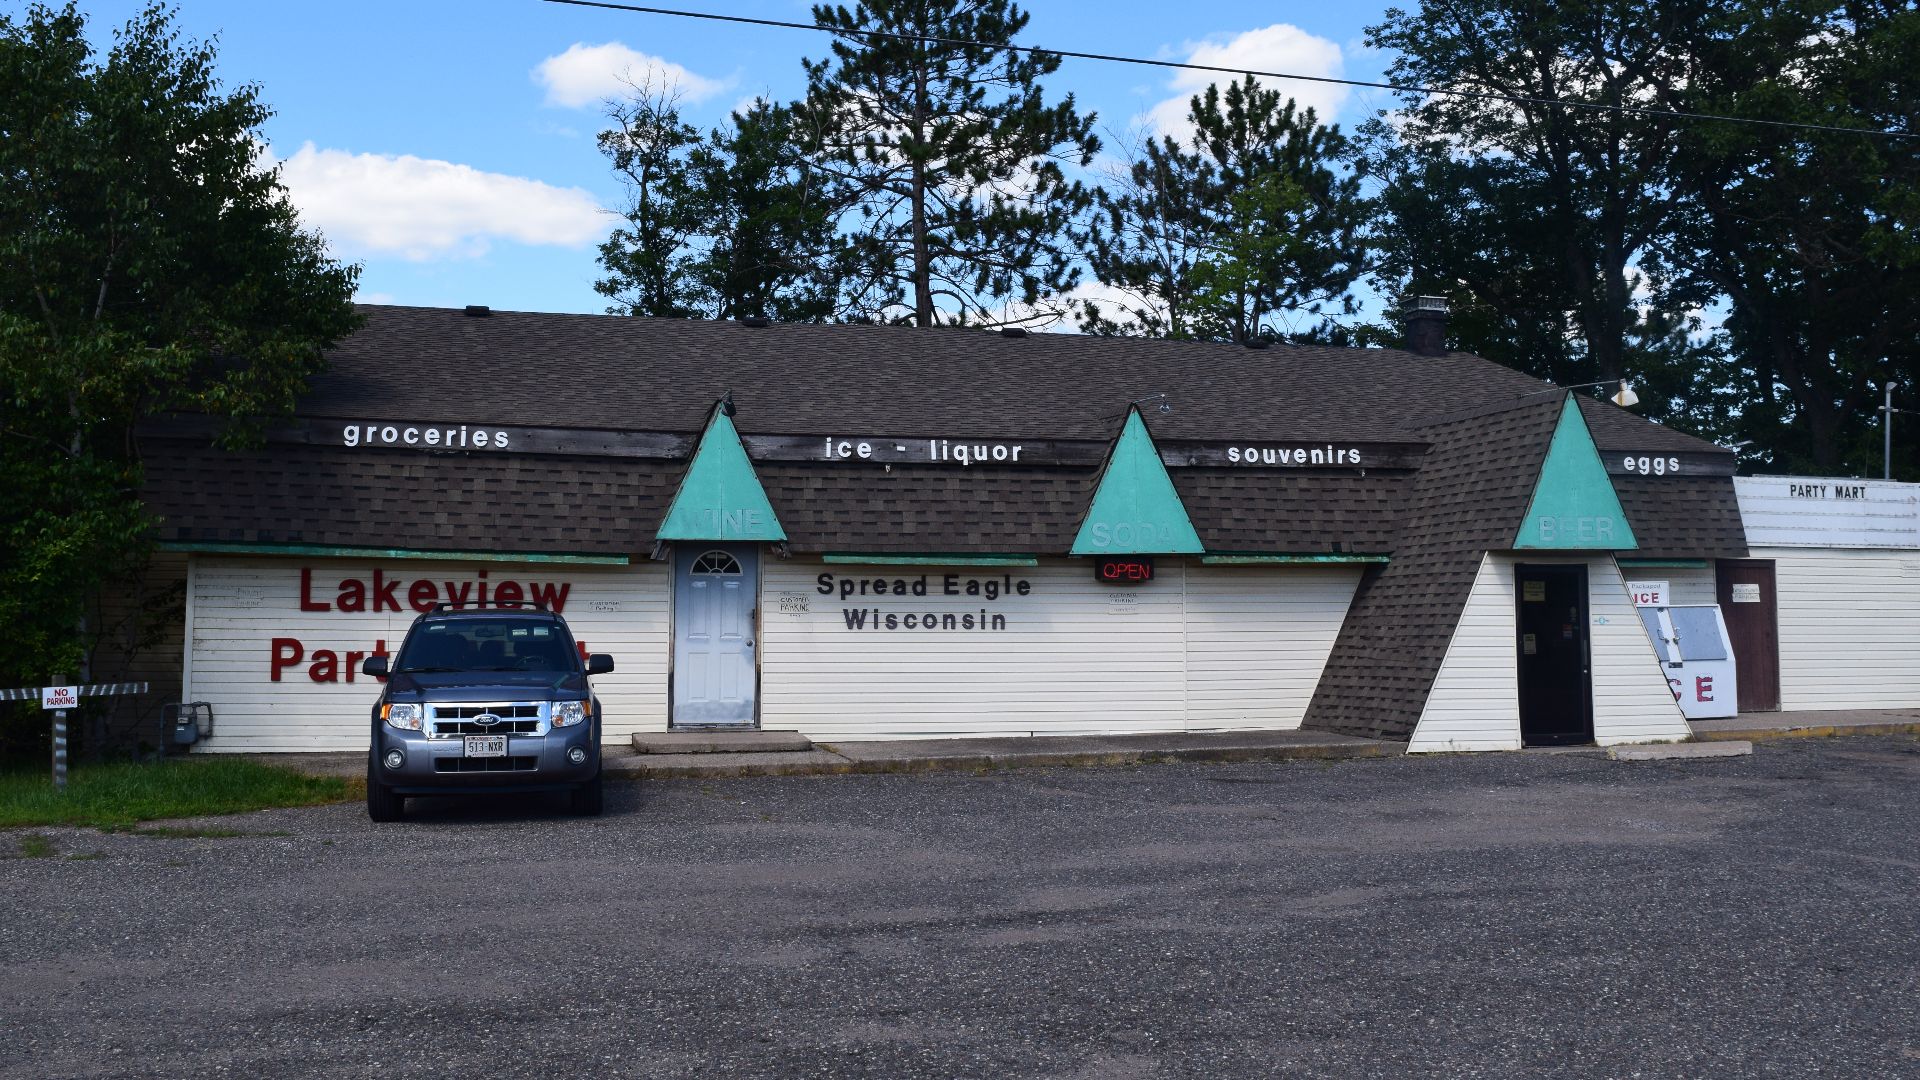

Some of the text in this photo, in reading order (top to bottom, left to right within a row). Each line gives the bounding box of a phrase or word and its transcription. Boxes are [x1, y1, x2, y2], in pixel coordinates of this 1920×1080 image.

[343, 425, 509, 448] groceries
[825, 437, 872, 459] ice
[930, 440, 1022, 465] liquor
[1228, 444, 1361, 464] souvenirs
[1623, 456, 1680, 476] eggs
[1790, 484, 1866, 499] PARTY MART
[1091, 522, 1177, 547] SODA
[1538, 516, 1615, 542] BEER
[1103, 563, 1150, 579] OPEN
[300, 568, 571, 614] Lakeview
[816, 573, 1031, 600] Spread Eagle
[1633, 592, 1660, 604] ICE
[843, 608, 1006, 630] Wisconsin
[46, 696, 76, 706] PARKING
[54, 688, 69, 697] NO
[468, 741, 504, 753] 513-NXR
